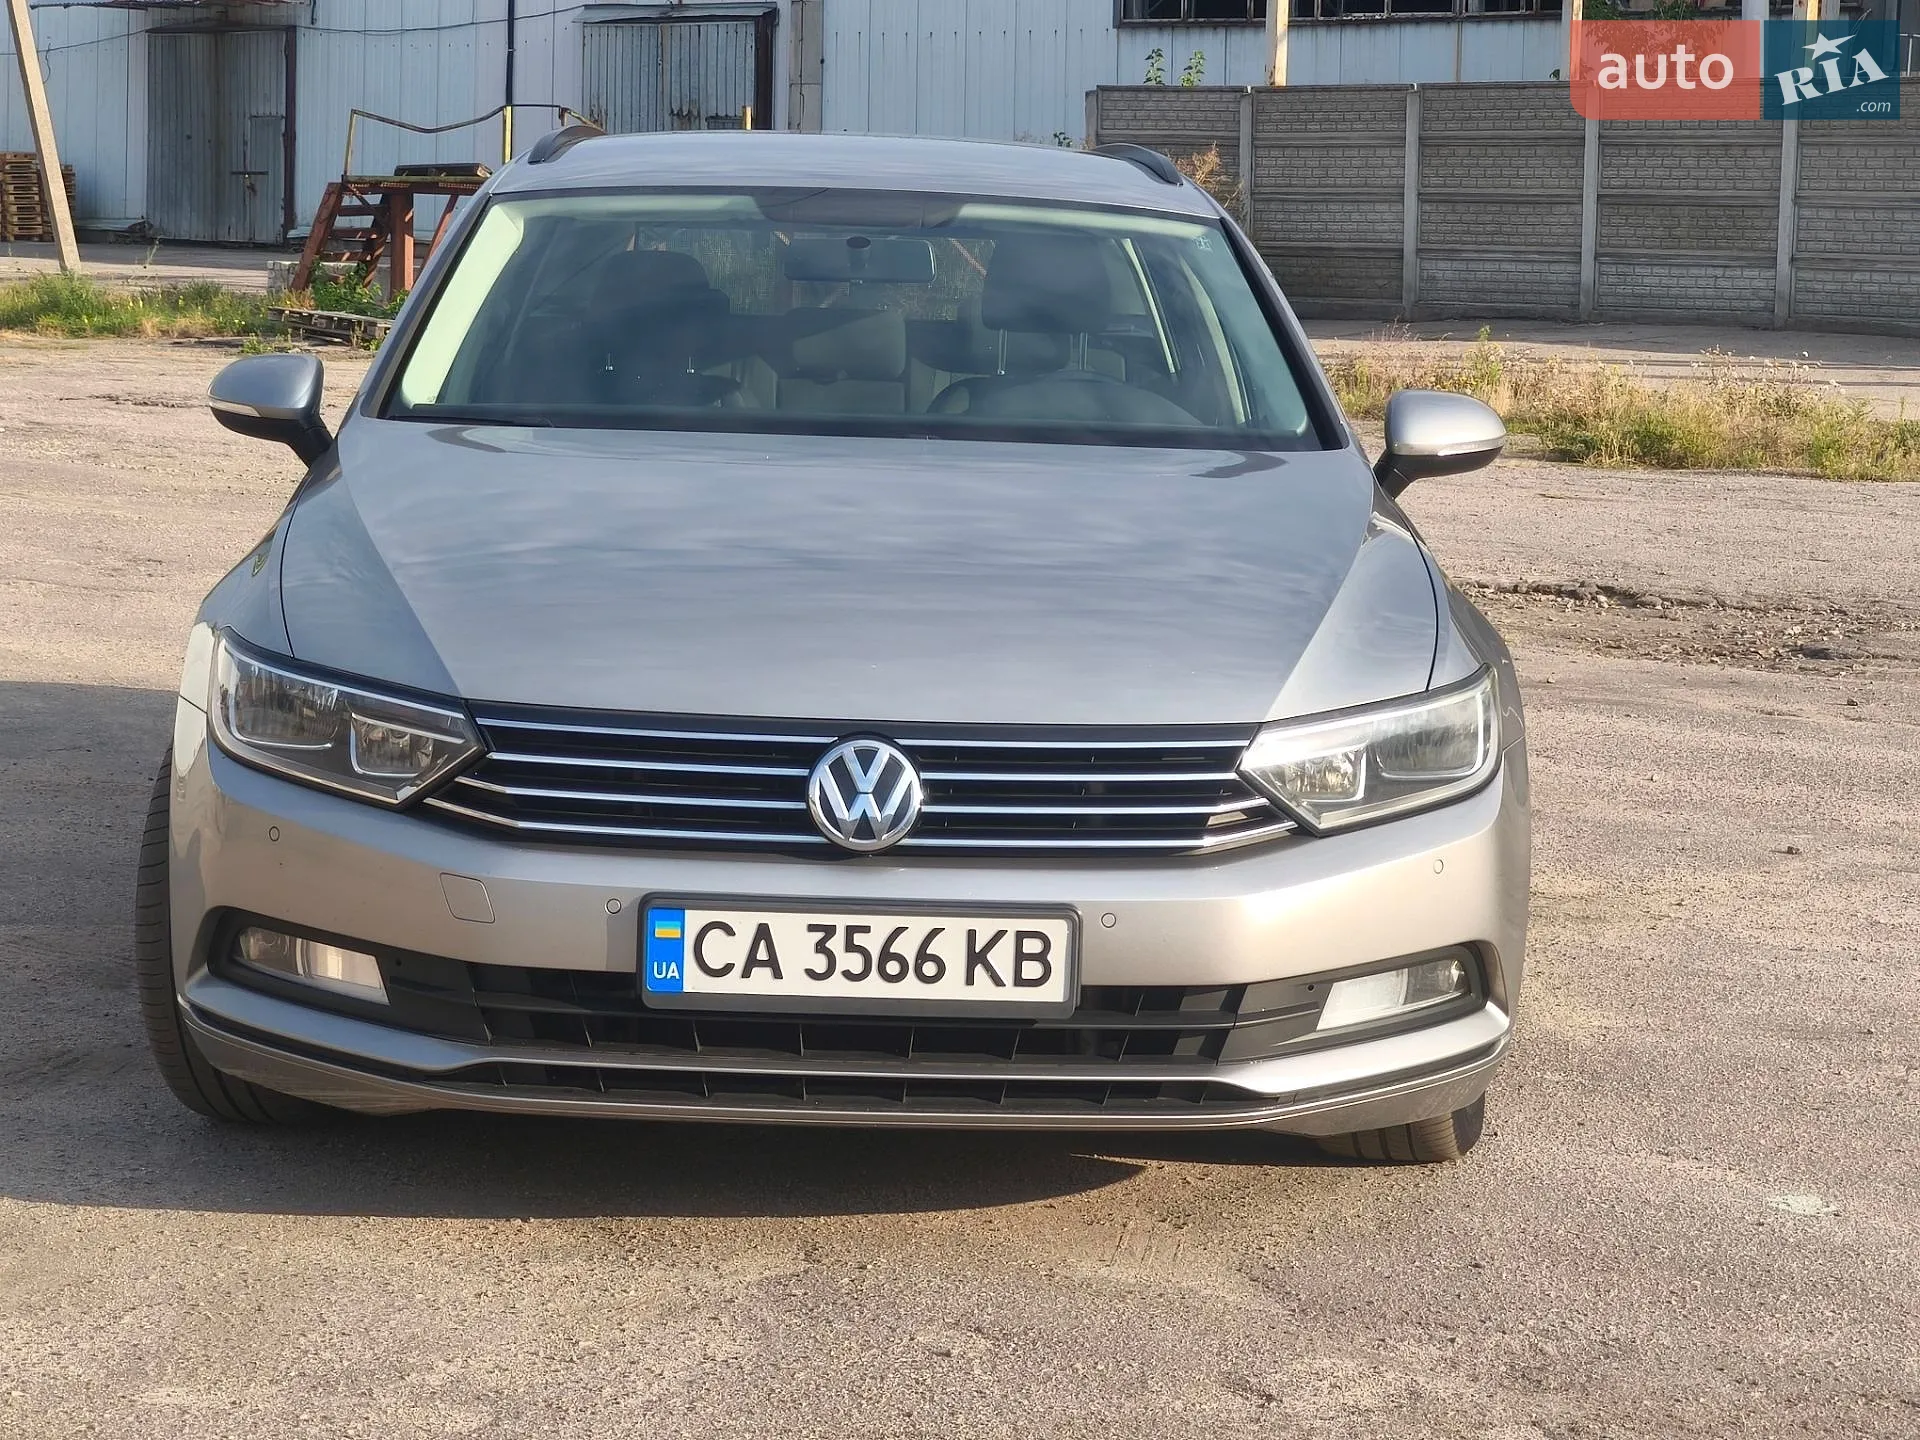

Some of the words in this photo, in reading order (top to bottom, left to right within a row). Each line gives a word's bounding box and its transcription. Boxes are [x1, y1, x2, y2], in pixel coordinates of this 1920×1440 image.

[653, 961, 680, 980] UA
[693, 920, 783, 980] CA
[804, 924, 946, 984] 3566
[965, 928, 1053, 988] KB
